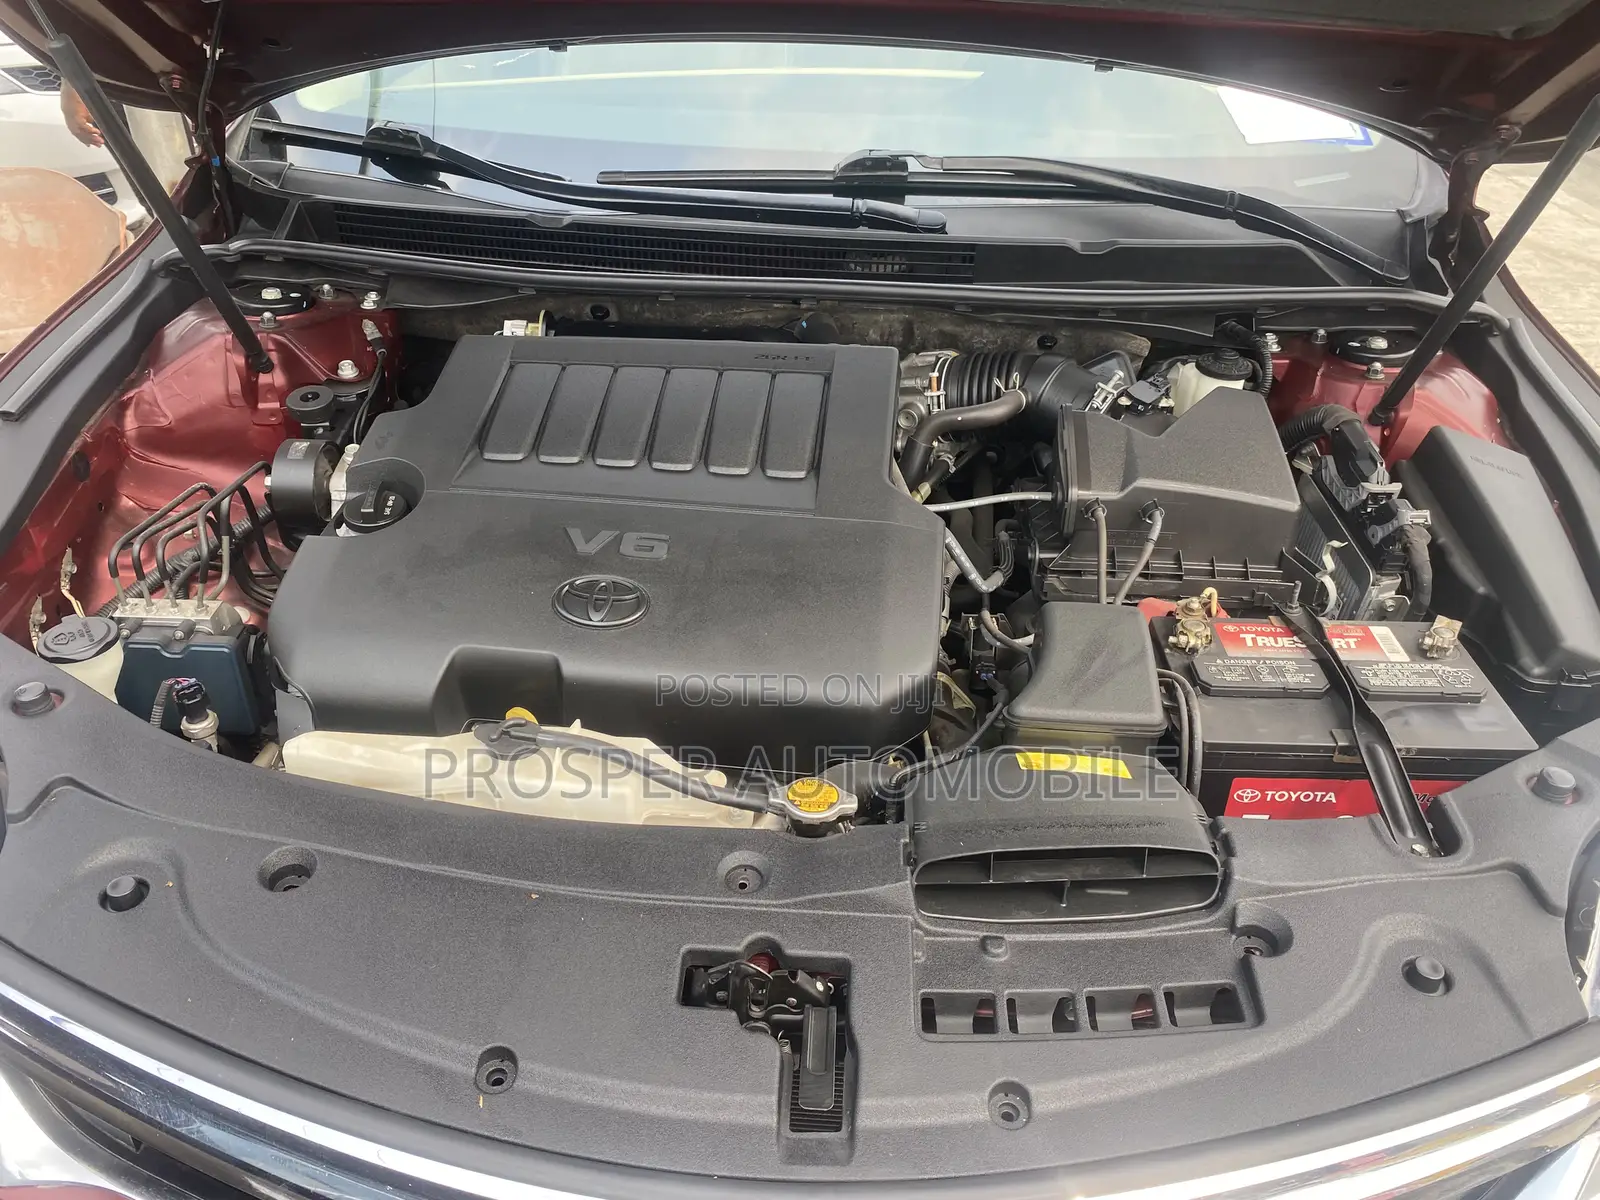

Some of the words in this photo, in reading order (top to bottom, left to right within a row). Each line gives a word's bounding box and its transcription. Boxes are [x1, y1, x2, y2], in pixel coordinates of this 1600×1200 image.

[564, 527, 671, 560] V6
[1239, 634, 1357, 648] TRUESRT
[1265, 791, 1337, 803] TOYOTA
